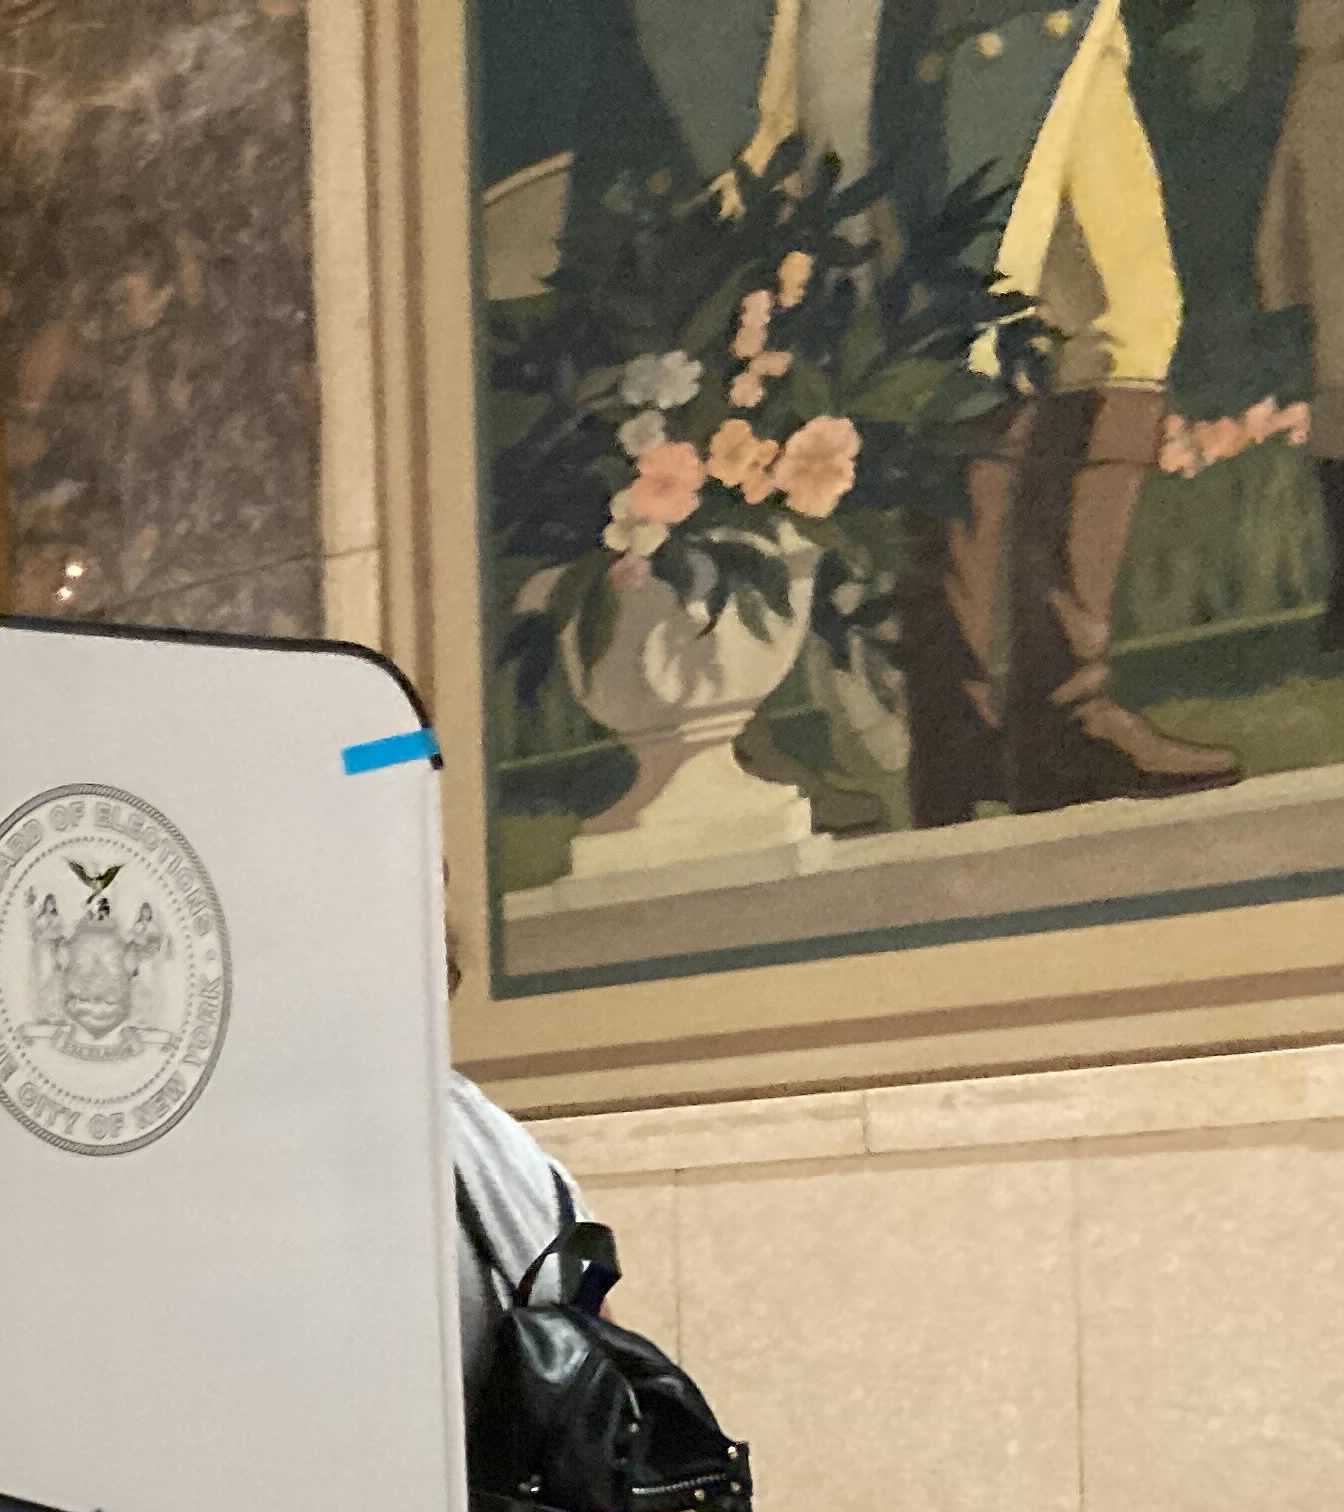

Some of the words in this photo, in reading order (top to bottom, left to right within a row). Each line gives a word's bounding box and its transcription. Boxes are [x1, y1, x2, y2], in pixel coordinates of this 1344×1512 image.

[48, 800, 86, 832] OF
[94, 800, 214, 938] ELECTIONS
[17, 1081, 83, 1136] CITY
[88, 1111, 125, 1141] OF
[181, 974, 224, 1068] YORK
